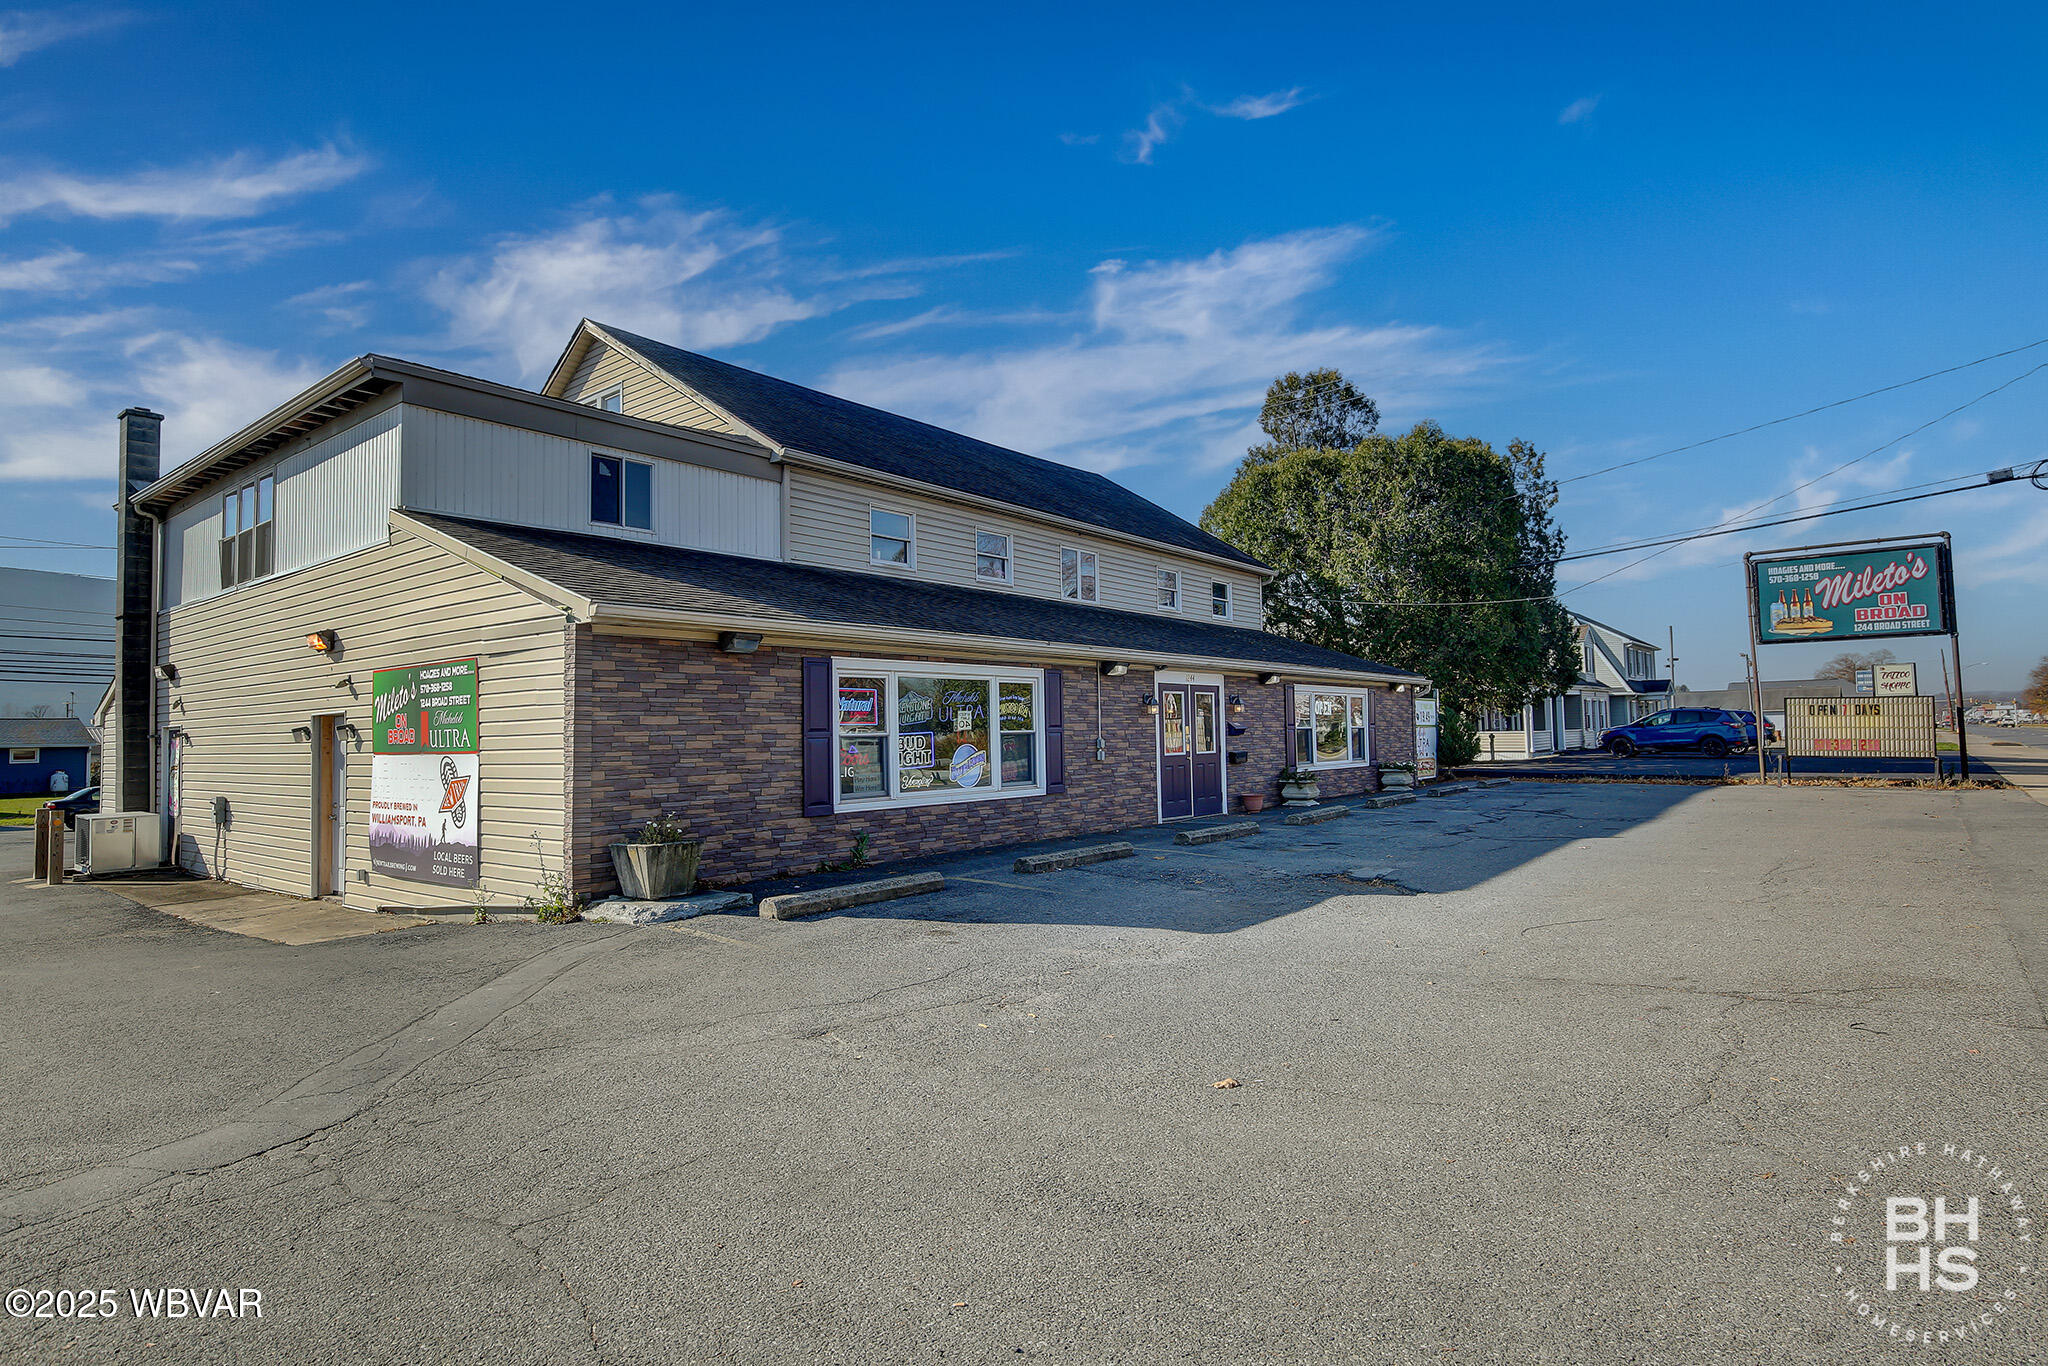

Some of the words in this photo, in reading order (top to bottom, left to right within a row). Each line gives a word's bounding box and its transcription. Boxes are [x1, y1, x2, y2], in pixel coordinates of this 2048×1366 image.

[1768, 565, 1798, 575] HOAGIES
[1799, 563, 1814, 573] AND
[1769, 574, 1819, 584] 570-368-1258
[1815, 552, 1929, 609] Mileto's
[1878, 592, 1907, 606] ON
[1855, 604, 1927, 623] BROAD
[1854, 622, 1873, 632] 1244
[1874, 621, 1901, 631] BROAD
[1902, 619, 1930, 629] STREET
[420, 669, 440, 680] HOAGIES
[440, 667, 452, 678] AND
[375, 673, 417, 723] Mileto's
[432, 697, 448, 708] BROAD
[449, 695, 471, 706] STREET
[1810, 705, 1836, 715] OPEN
[1842, 705, 1847, 715] 7
[1855, 705, 1880, 715] DAYS
[395, 713, 407, 729] ON
[388, 728, 415, 744] BROAD
[430, 729, 471, 748] ULTRA
[899, 736, 926, 751] BUD
[899, 750, 931, 766] IGHT
[372, 801, 393, 810] PROUDLY
[394, 802, 412, 811] BREWED
[413, 803, 418, 811] IN
[372, 813, 417, 827] WILLIAMSPORT,
[418, 817, 427, 828] PA
[433, 851, 452, 863] LOCAL
[454, 853, 473, 865] BEERS
[432, 865, 448, 876] SOLD
[449, 867, 465, 878] HERE
